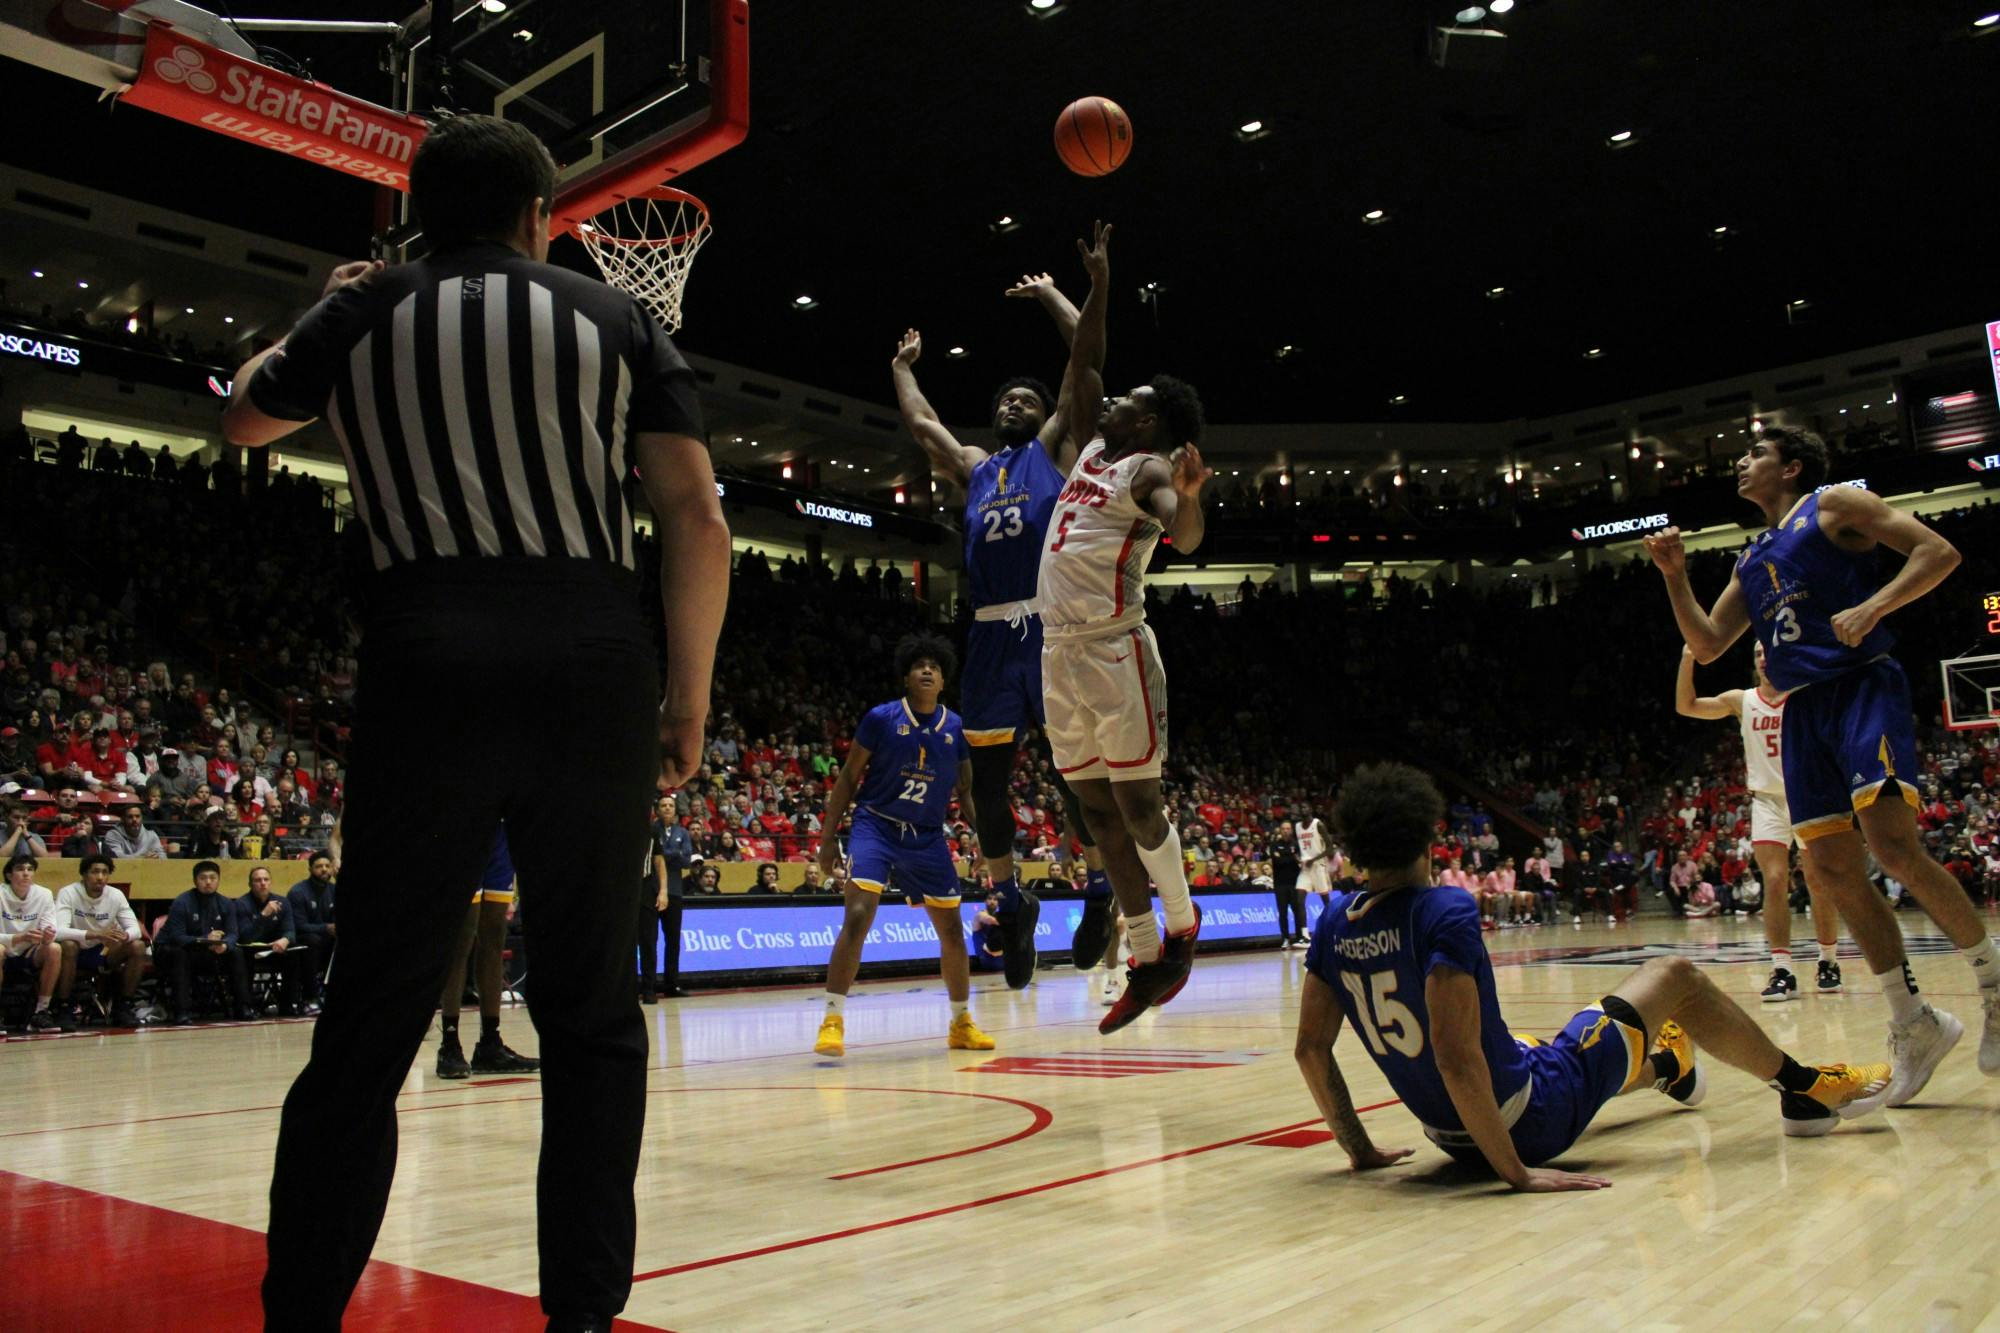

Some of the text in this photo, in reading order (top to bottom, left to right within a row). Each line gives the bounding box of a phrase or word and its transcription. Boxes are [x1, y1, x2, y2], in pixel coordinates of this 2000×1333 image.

[805, 502, 873, 528] FLOORSCAPES
[983, 506, 1024, 543] 23
[1584, 513, 1670, 539] FLOORSCAPES
[1050, 511, 1077, 552] 5
[898, 779, 928, 804] 22
[1215, 908, 1242, 925] Blue
[1243, 907, 1275, 924] Shield
[681, 929, 733, 952] Blue
[737, 927, 794, 950] Cross
[799, 924, 835, 948] and
[884, 921, 939, 943] Shield
[1340, 970, 1424, 1058] 15
